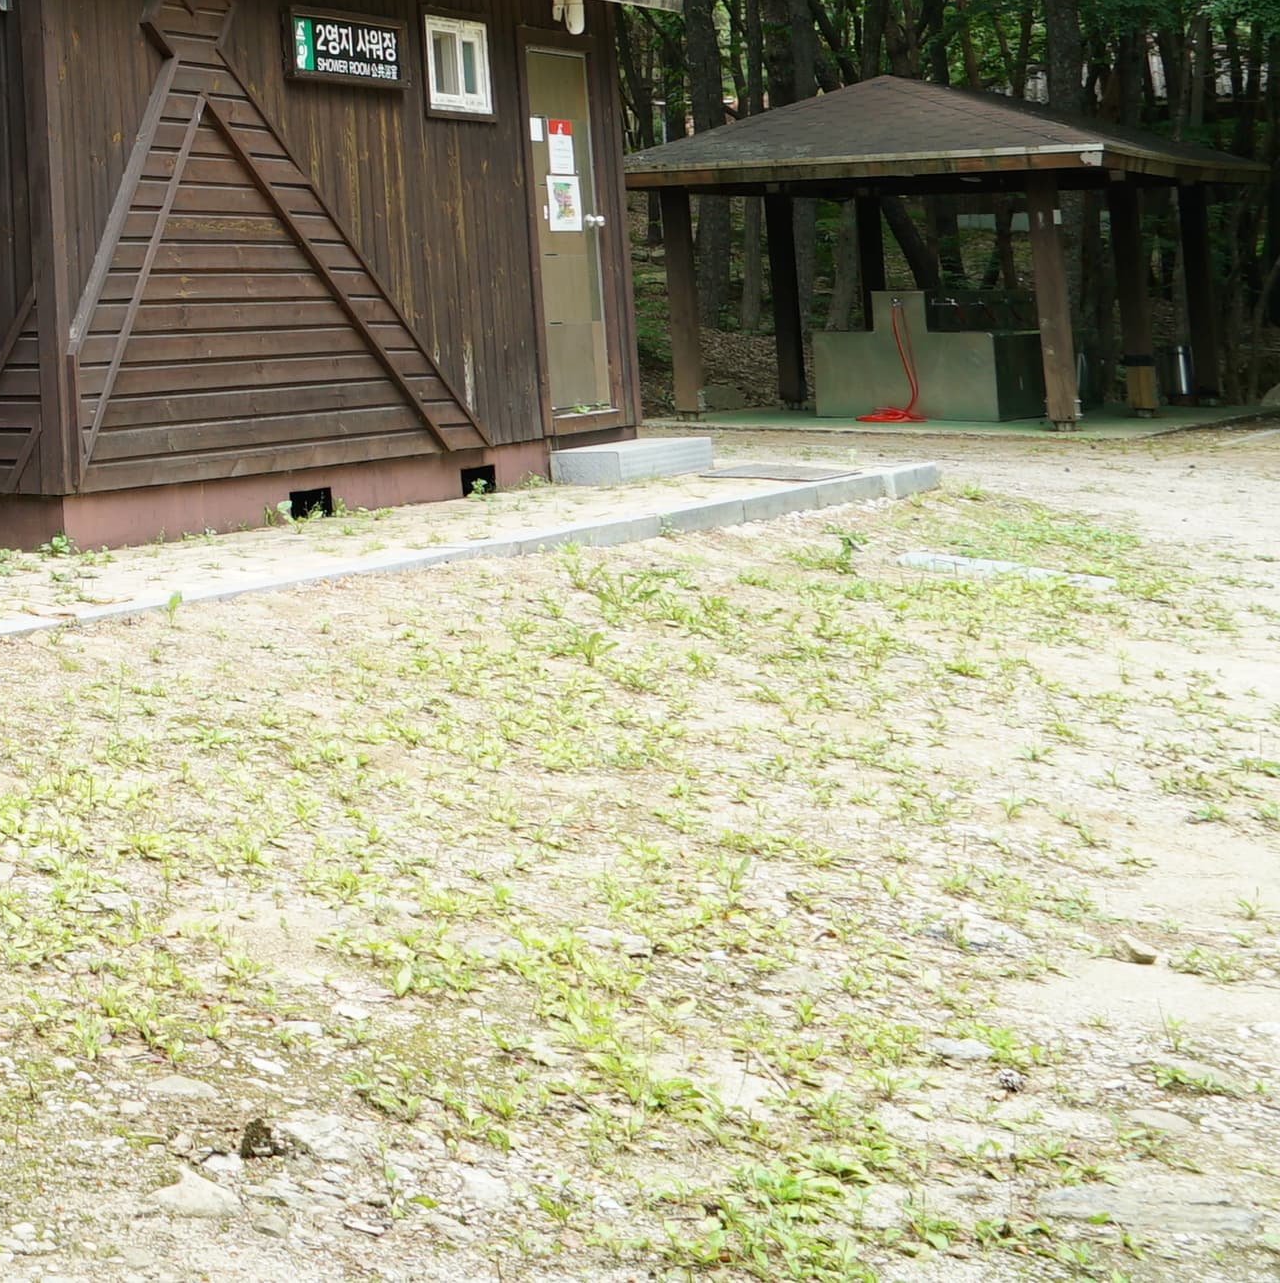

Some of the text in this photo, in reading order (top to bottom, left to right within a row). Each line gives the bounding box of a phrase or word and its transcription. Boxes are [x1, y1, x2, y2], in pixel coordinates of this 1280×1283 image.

[315, 24, 397, 62] 2영지 샤워장
[317, 57, 349, 74] SHOWER
[349, 61, 371, 76] ROOM
